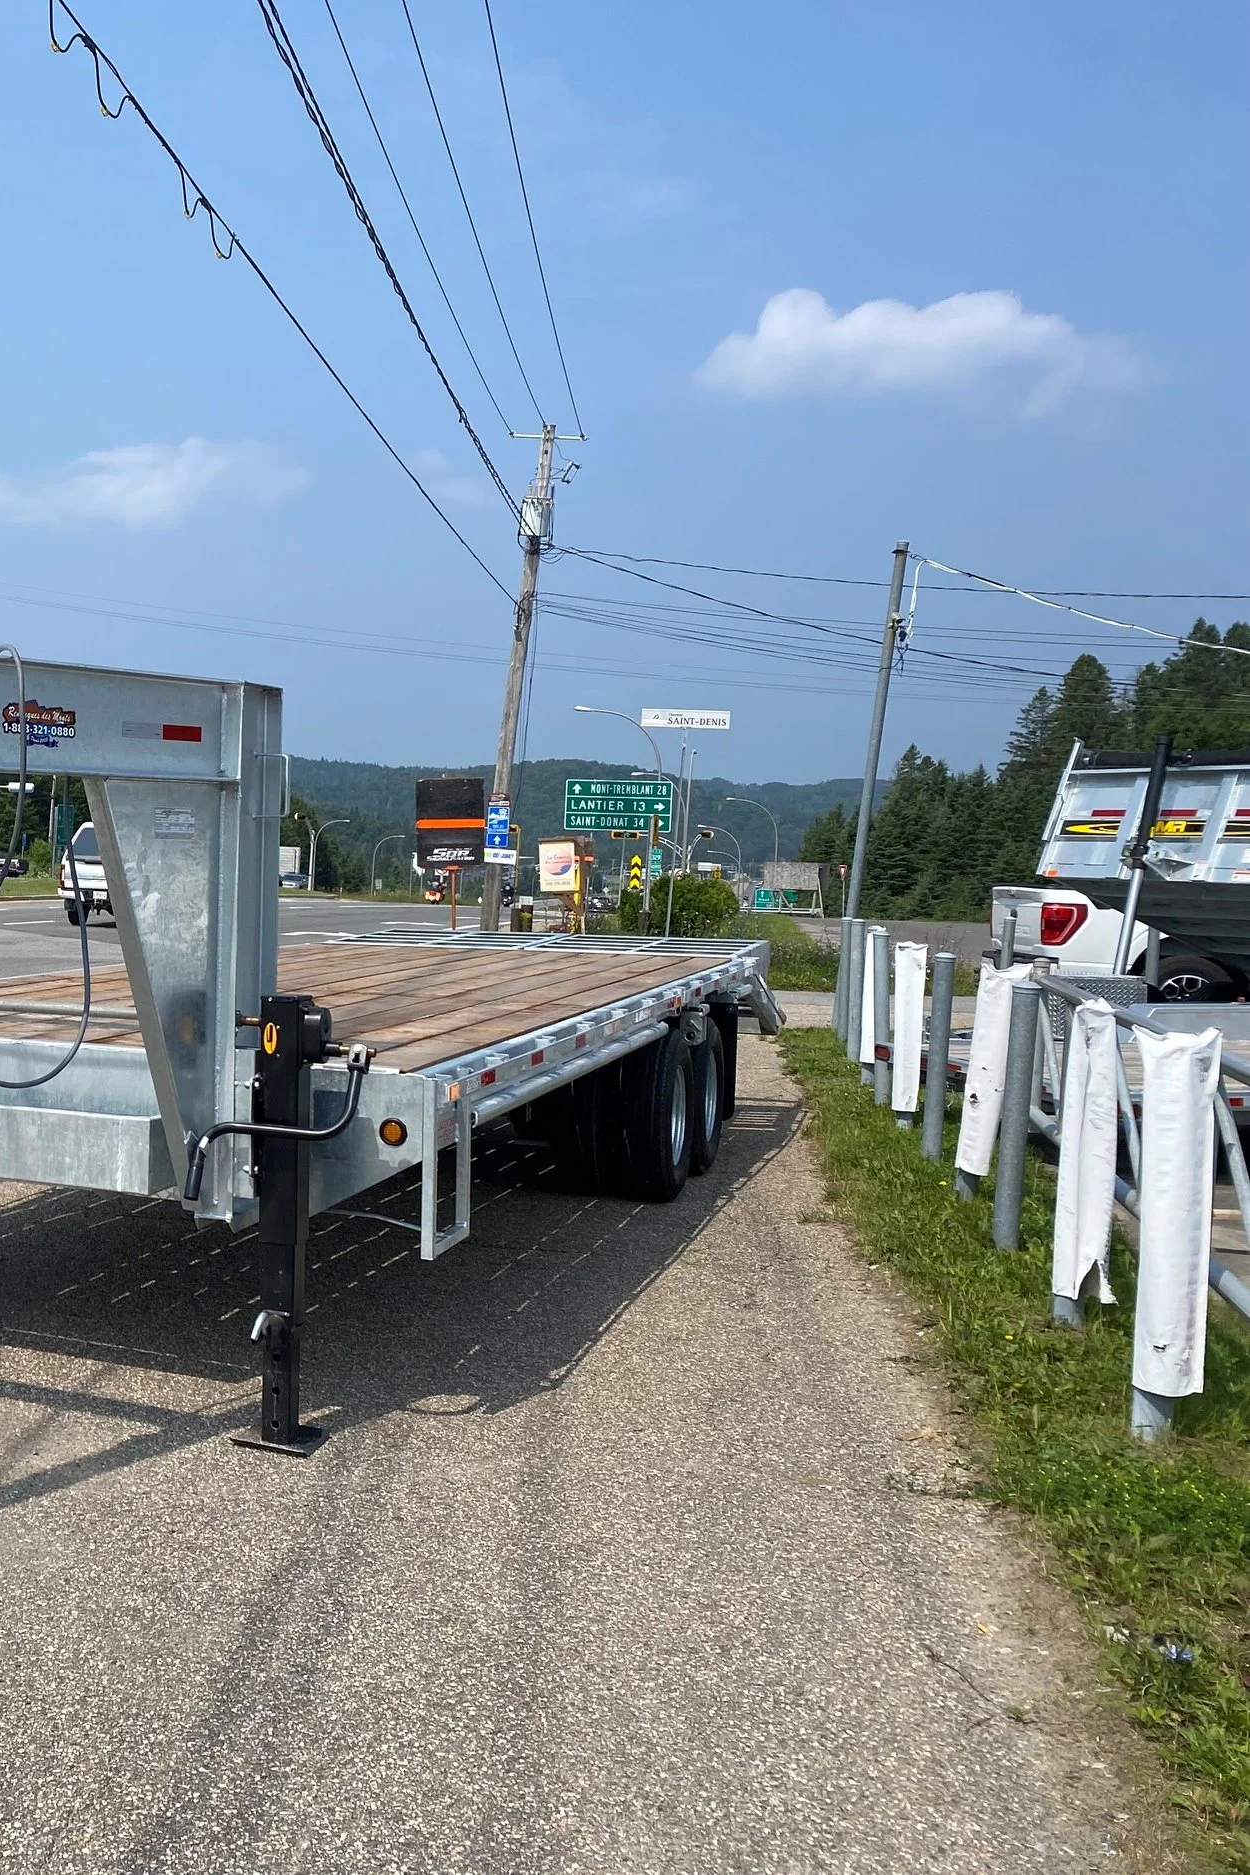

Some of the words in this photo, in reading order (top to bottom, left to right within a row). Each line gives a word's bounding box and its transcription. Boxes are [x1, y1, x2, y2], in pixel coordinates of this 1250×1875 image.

[41, 711, 51, 720] des
[667, 717, 727, 726] SAINT-DENIS
[590, 784, 654, 795] MONT-TREMBLANT
[656, 785, 667, 795] 28
[571, 800, 624, 810] LANTIER
[633, 801, 646, 812] 13
[570, 816, 629, 827] SAINT-DONAT
[633, 818, 644, 828] 34
